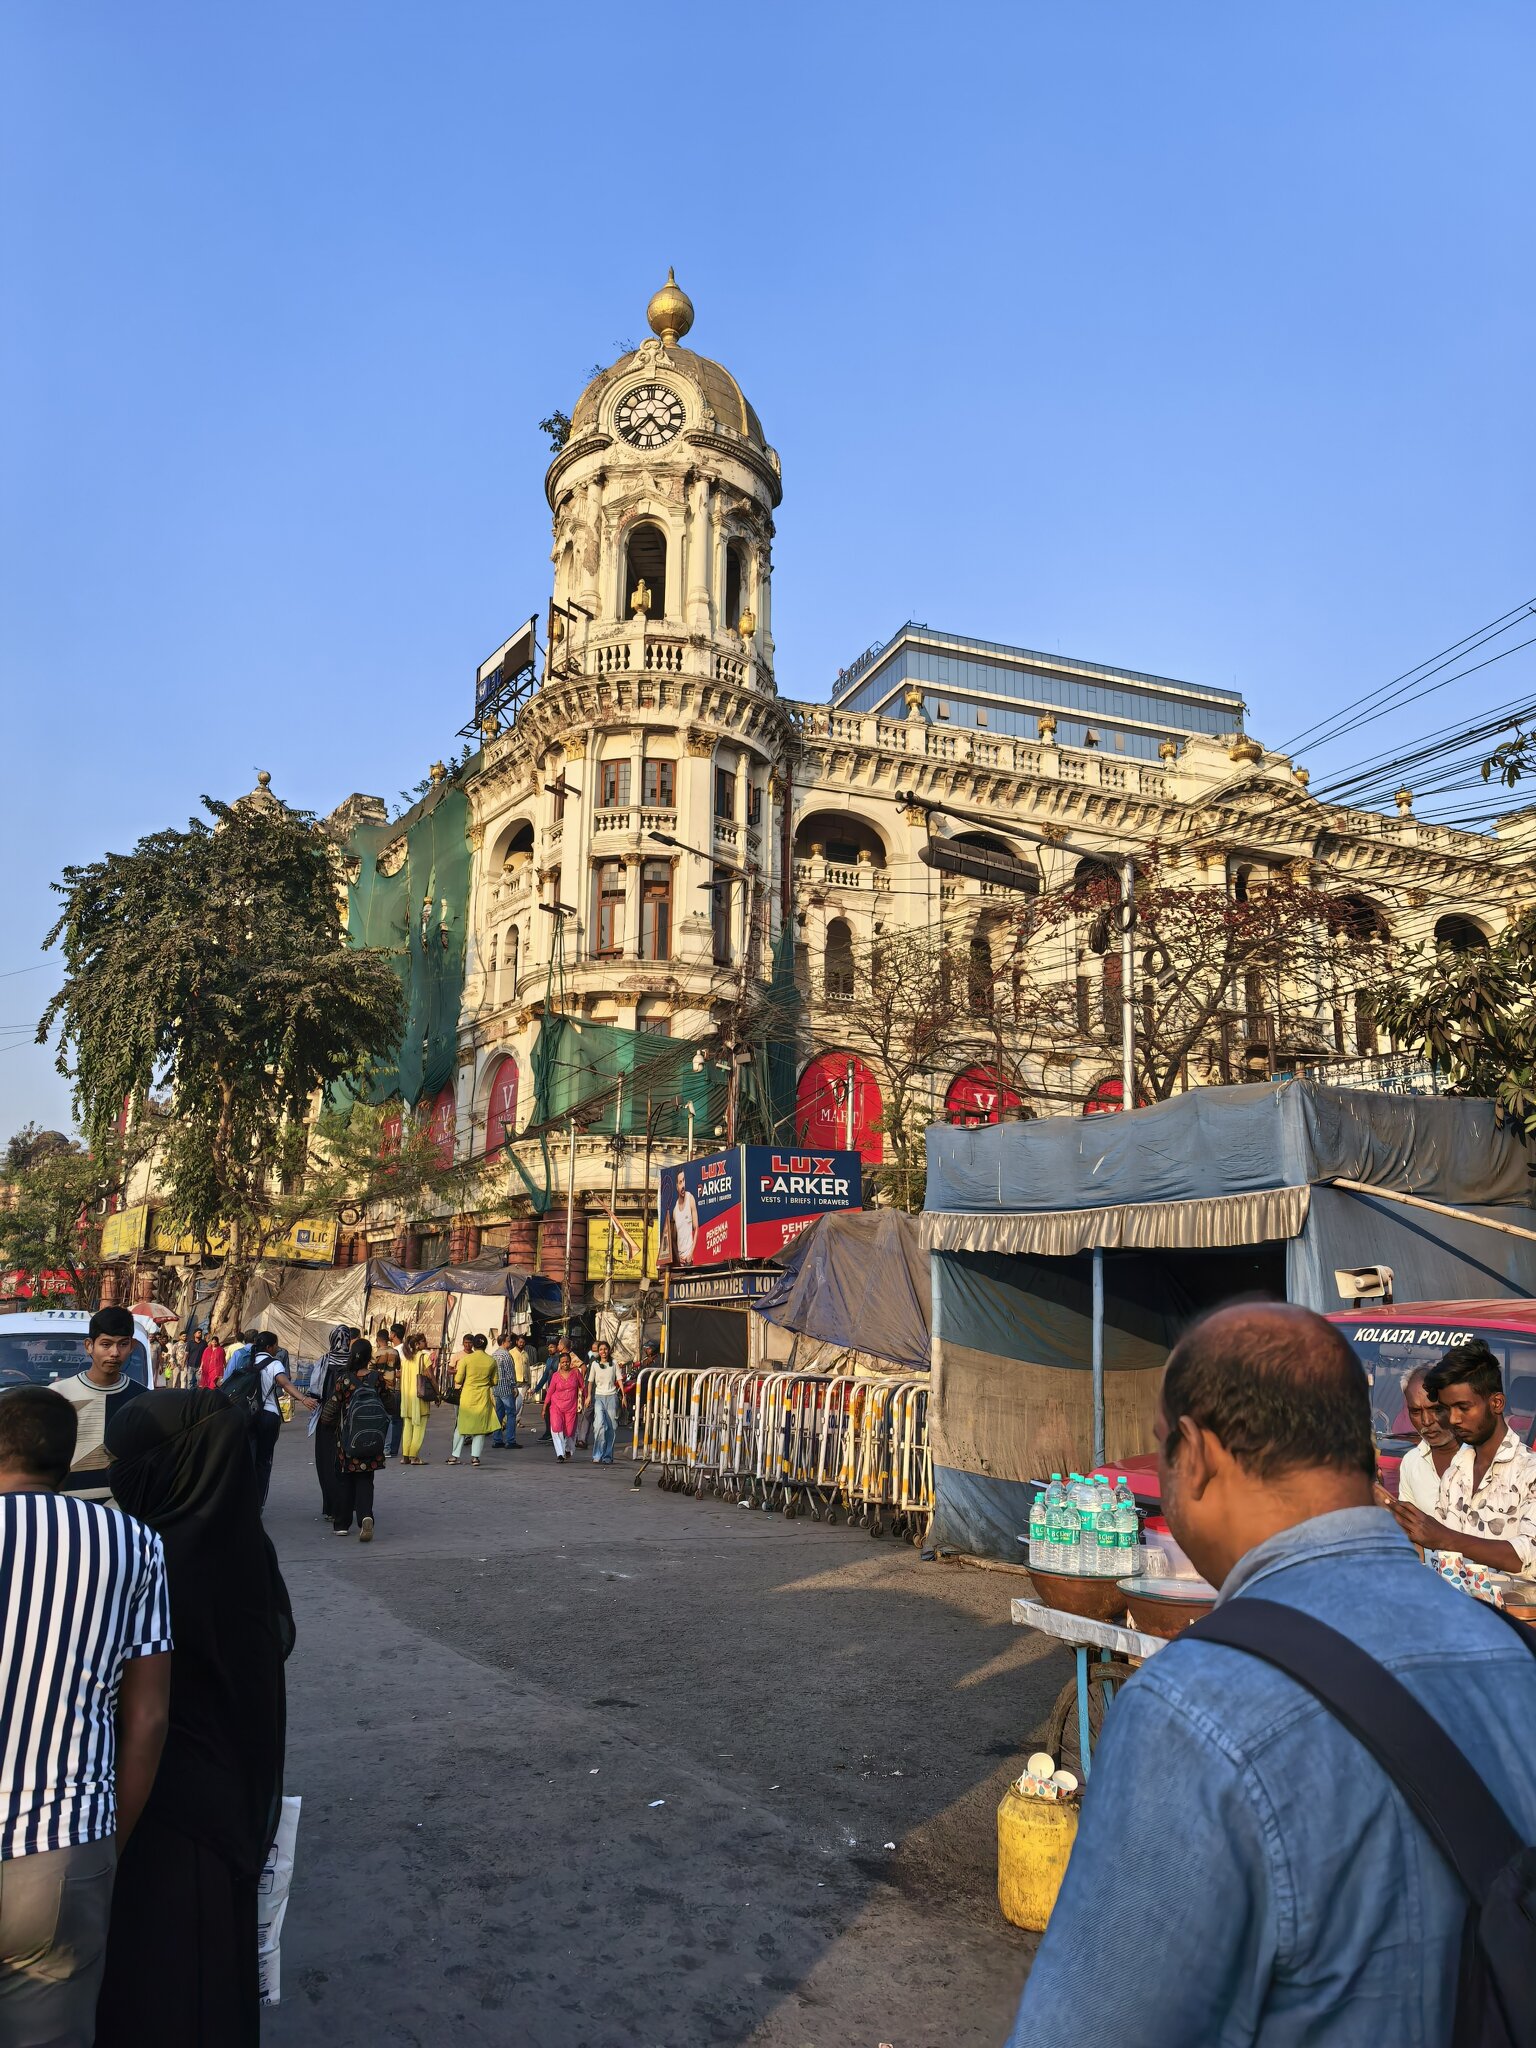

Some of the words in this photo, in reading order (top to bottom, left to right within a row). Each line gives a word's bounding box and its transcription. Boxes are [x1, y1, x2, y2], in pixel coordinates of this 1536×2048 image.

[701, 1160, 727, 1181] LUX
[772, 1155, 836, 1175] LUX
[697, 1176, 732, 1198] PARKER
[760, 1176, 848, 1196] PARKER
[790, 1197, 811, 1205] BRIEFS
[819, 1198, 849, 1206] DRAWERS
[782, 1220, 816, 1234] PEHE
[312, 1232, 328, 1243] LIC
[674, 1281, 711, 1299] KOLKATA
[713, 1278, 744, 1296] POLICE
[1353, 1328, 1416, 1343] KOLKATA
[1417, 1330, 1474, 1346] POLICE
